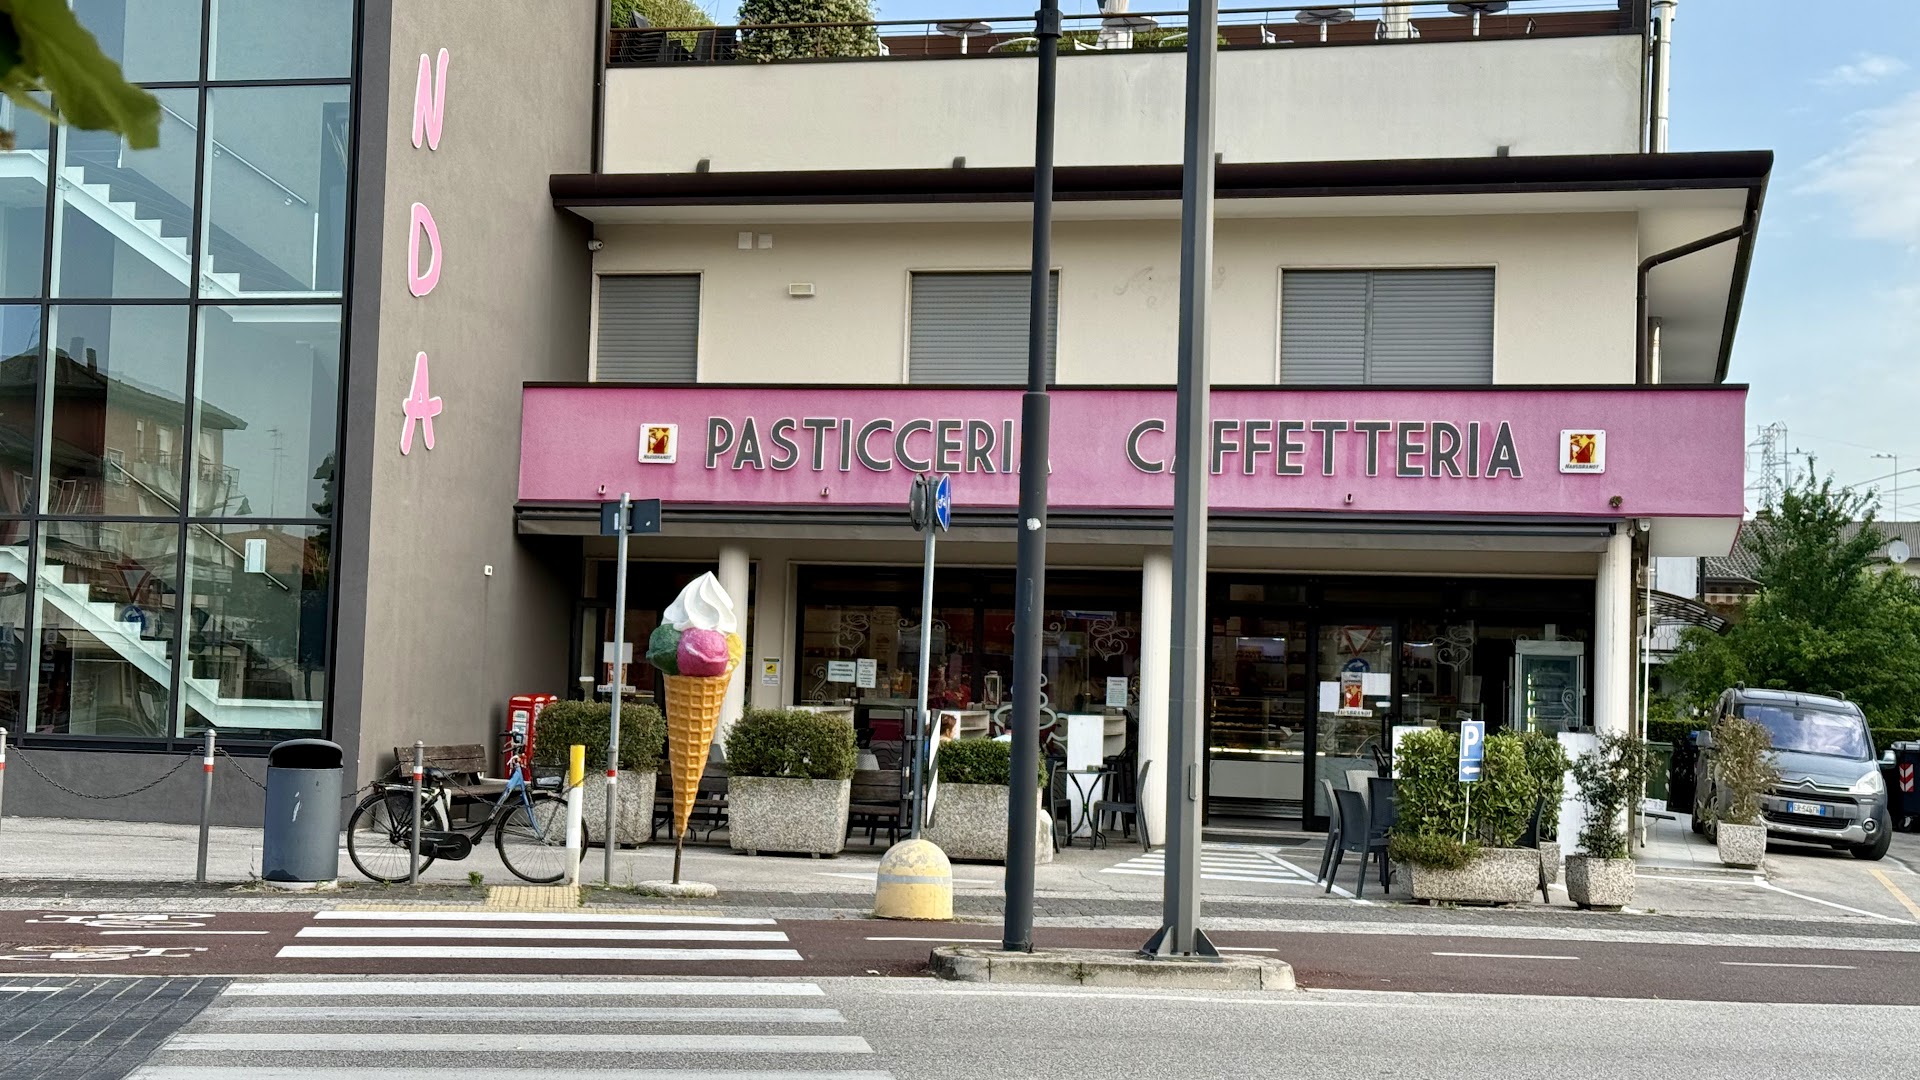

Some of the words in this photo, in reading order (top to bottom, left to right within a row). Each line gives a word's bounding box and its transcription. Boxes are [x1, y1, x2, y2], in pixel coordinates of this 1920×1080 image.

[705, 416, 1052, 474] PASTICCERI
[1125, 418, 1524, 479] CFFETTERIA
[1463, 725, 1479, 757] P
